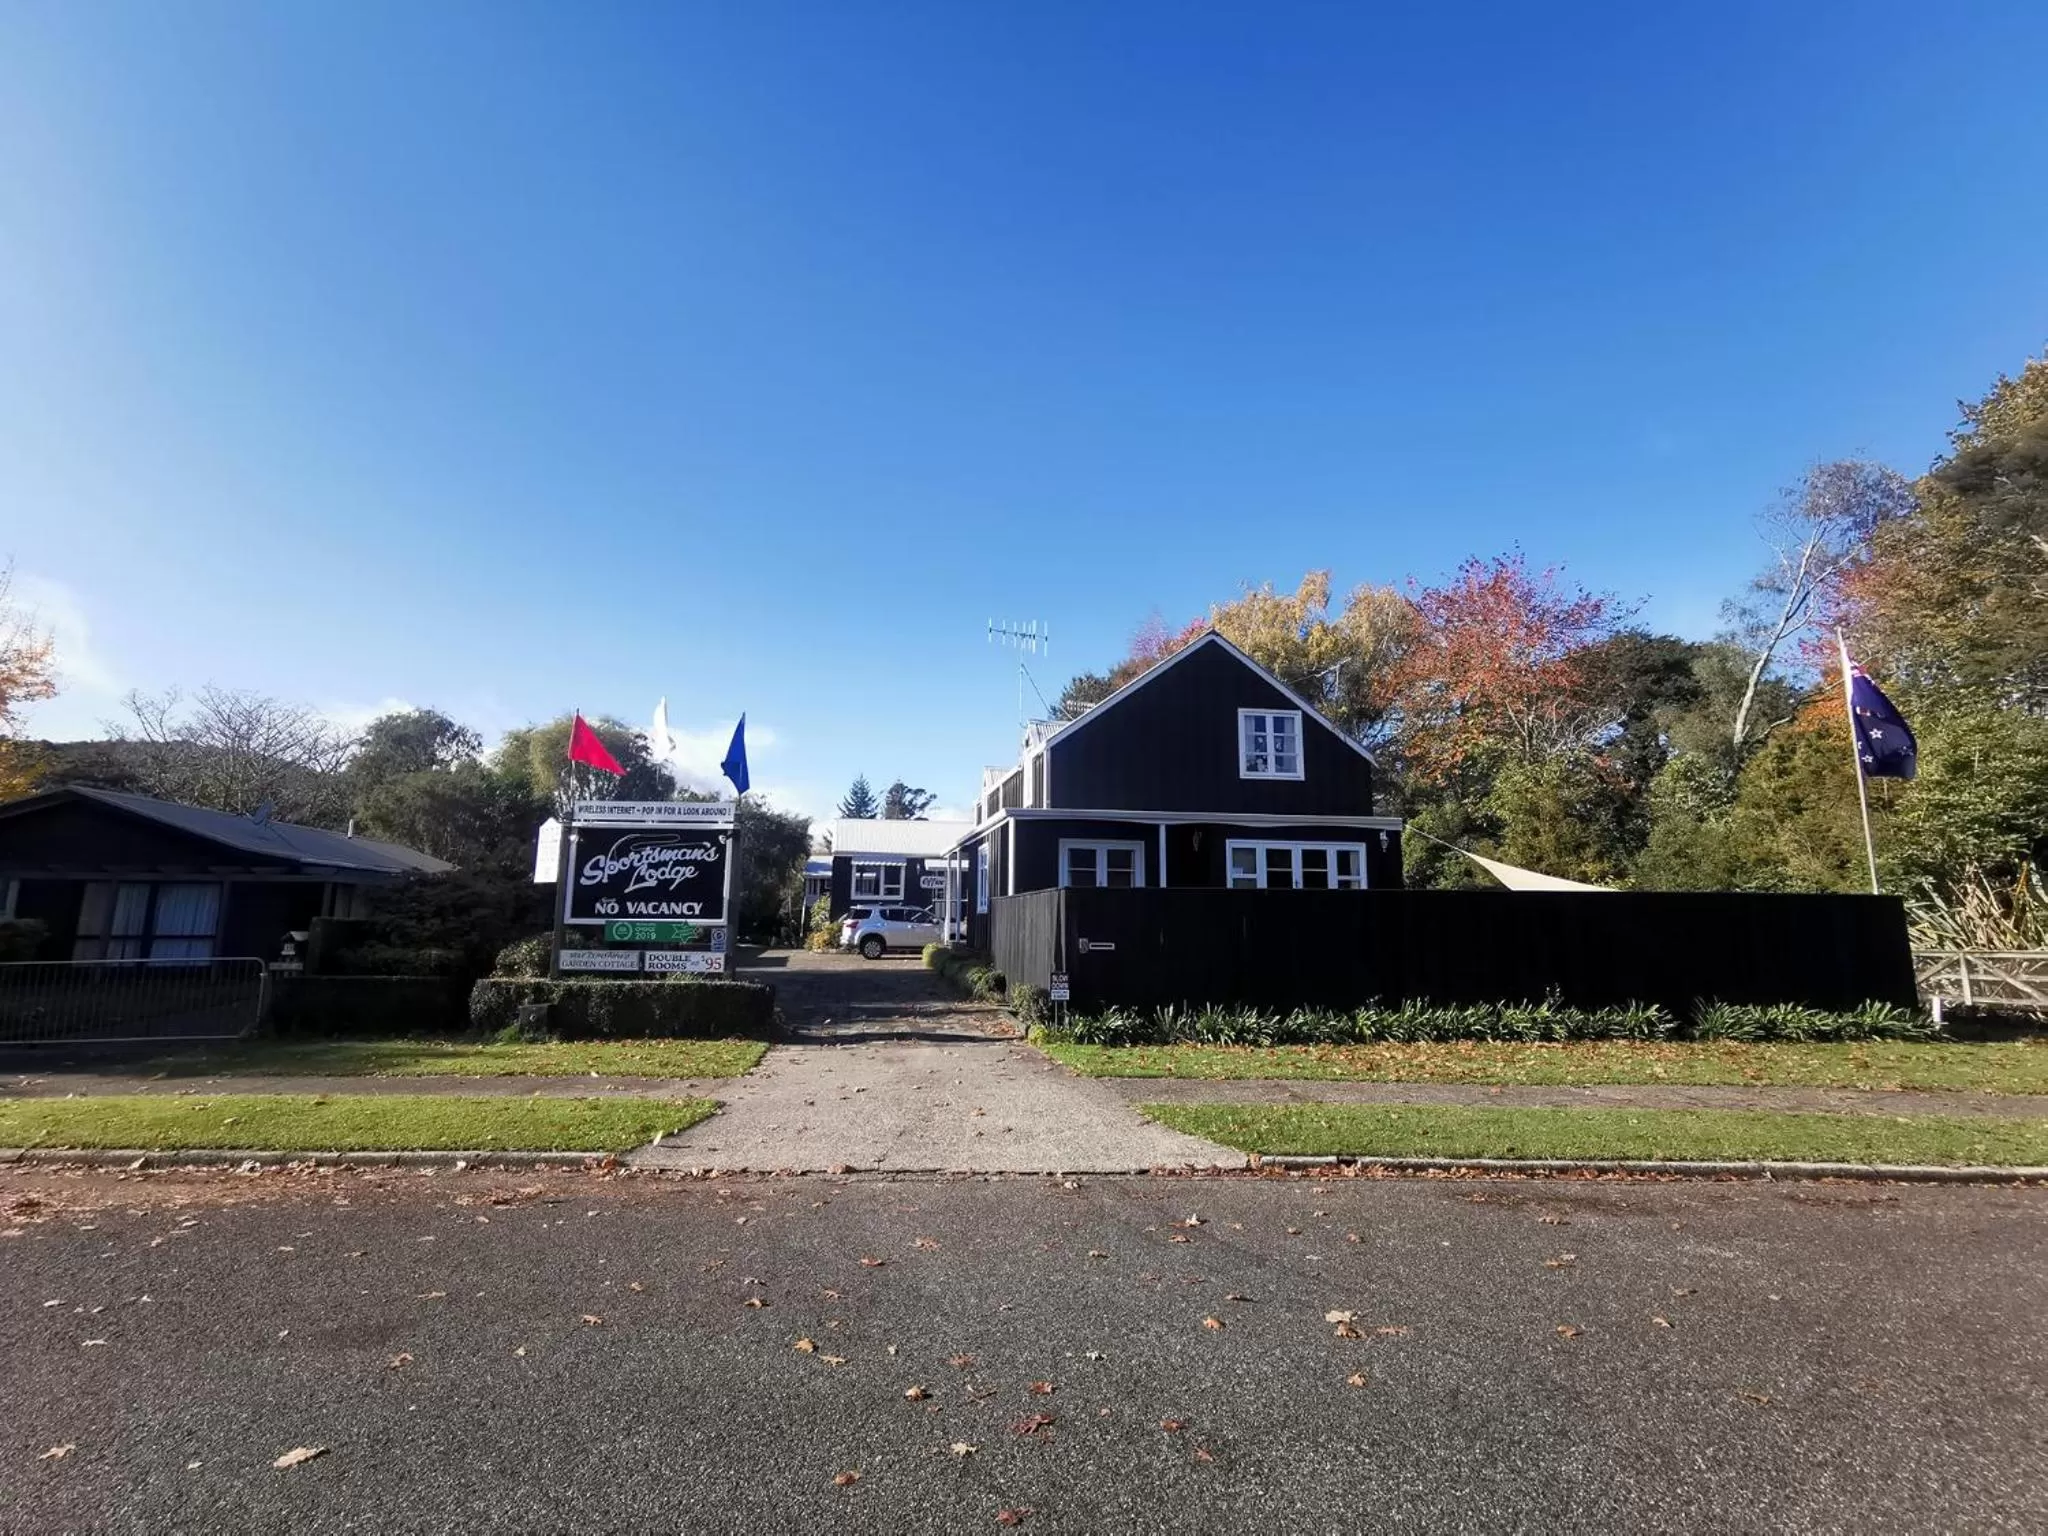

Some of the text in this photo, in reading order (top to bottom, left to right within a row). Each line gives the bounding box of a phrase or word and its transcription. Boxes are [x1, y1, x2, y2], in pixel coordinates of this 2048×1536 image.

[578, 805, 607, 814] WIRELESS
[608, 805, 635, 815] INTERNET
[641, 806, 655, 816] POP
[664, 807, 676, 816] FOR
[683, 807, 699, 816] LOOK
[580, 843, 720, 886] Sportsman's
[624, 861, 699, 894] Lodge
[595, 901, 703, 915] NO VACANCY
[635, 932, 656, 940] 2019
[649, 954, 690, 962] DOUBLE
[562, 960, 637, 969] GARDEN COTTAGE
[648, 962, 687, 970] ROOMS
